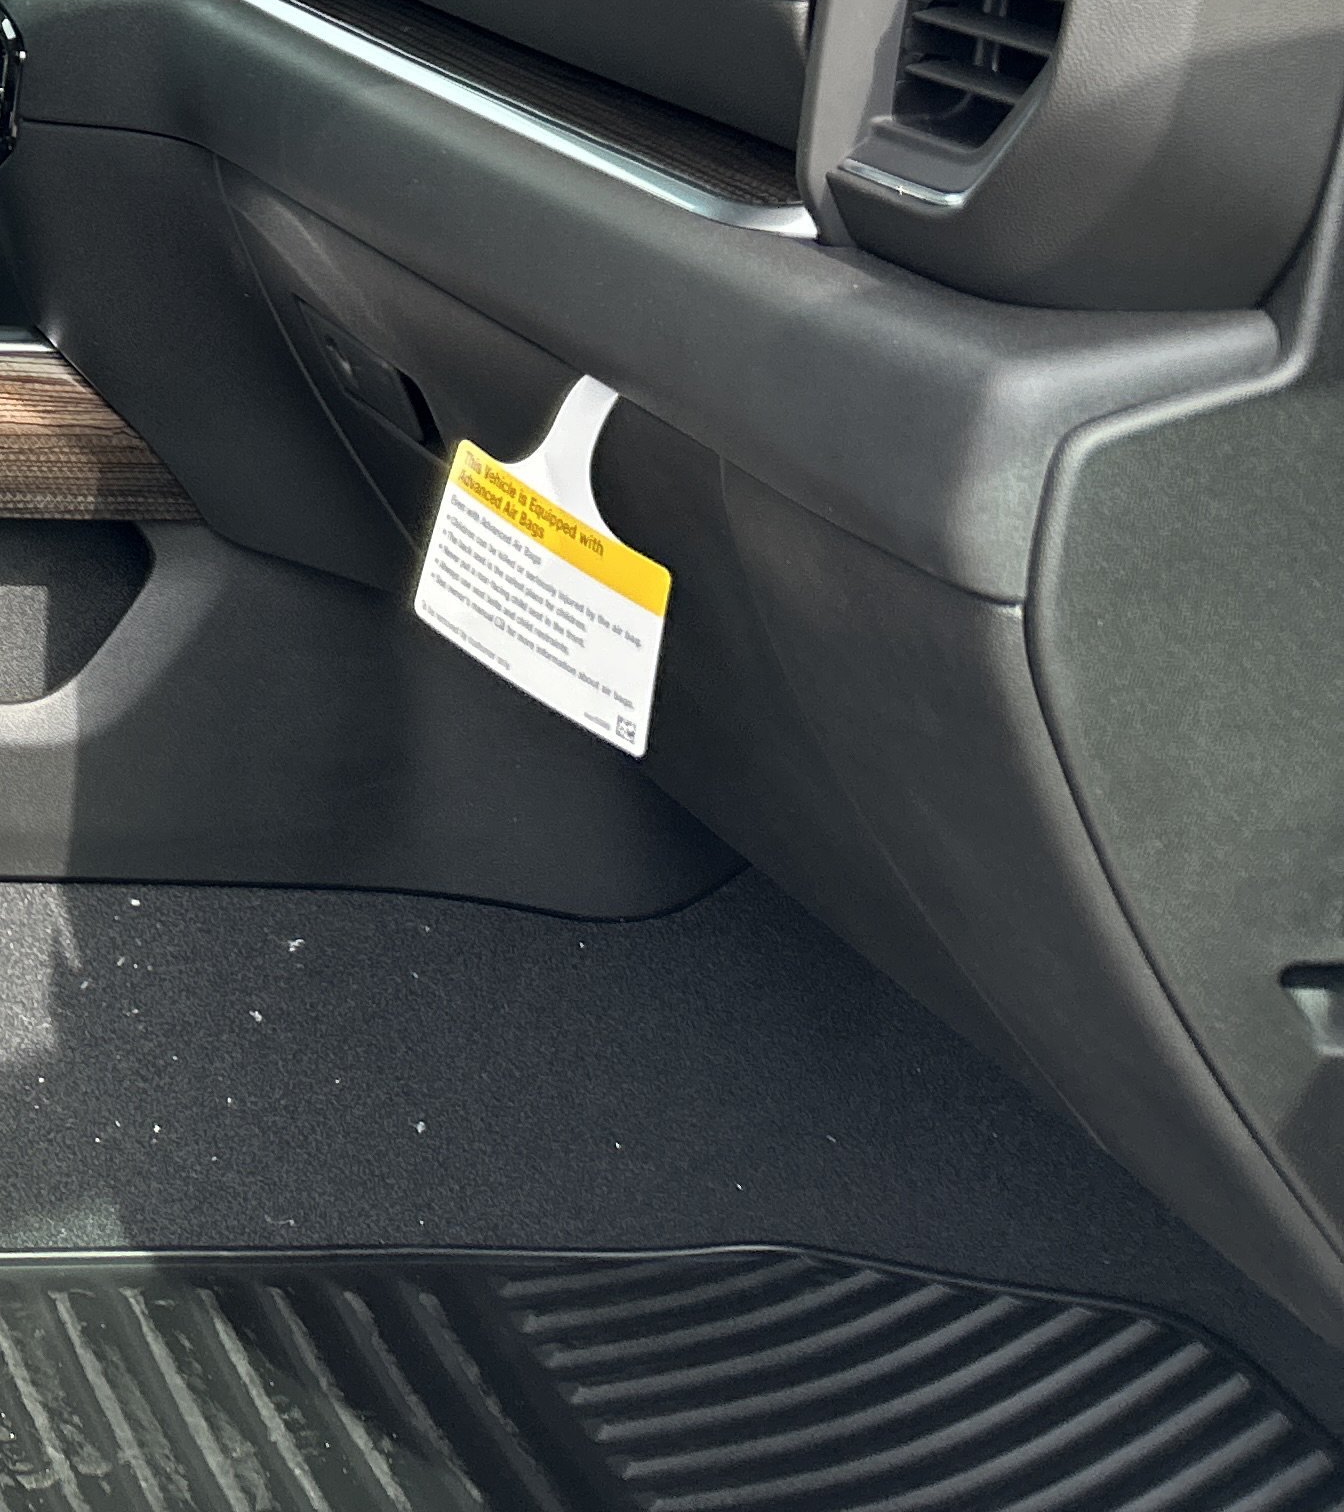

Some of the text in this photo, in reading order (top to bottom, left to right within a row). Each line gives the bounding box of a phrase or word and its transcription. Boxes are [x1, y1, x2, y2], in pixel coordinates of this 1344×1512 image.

[457, 469, 545, 539] Advanced Air Bags
[483, 464, 517, 499] Vehicle
[517, 487, 528, 507] is
[528, 495, 578, 540] Equipped
[578, 531, 604, 557] with
